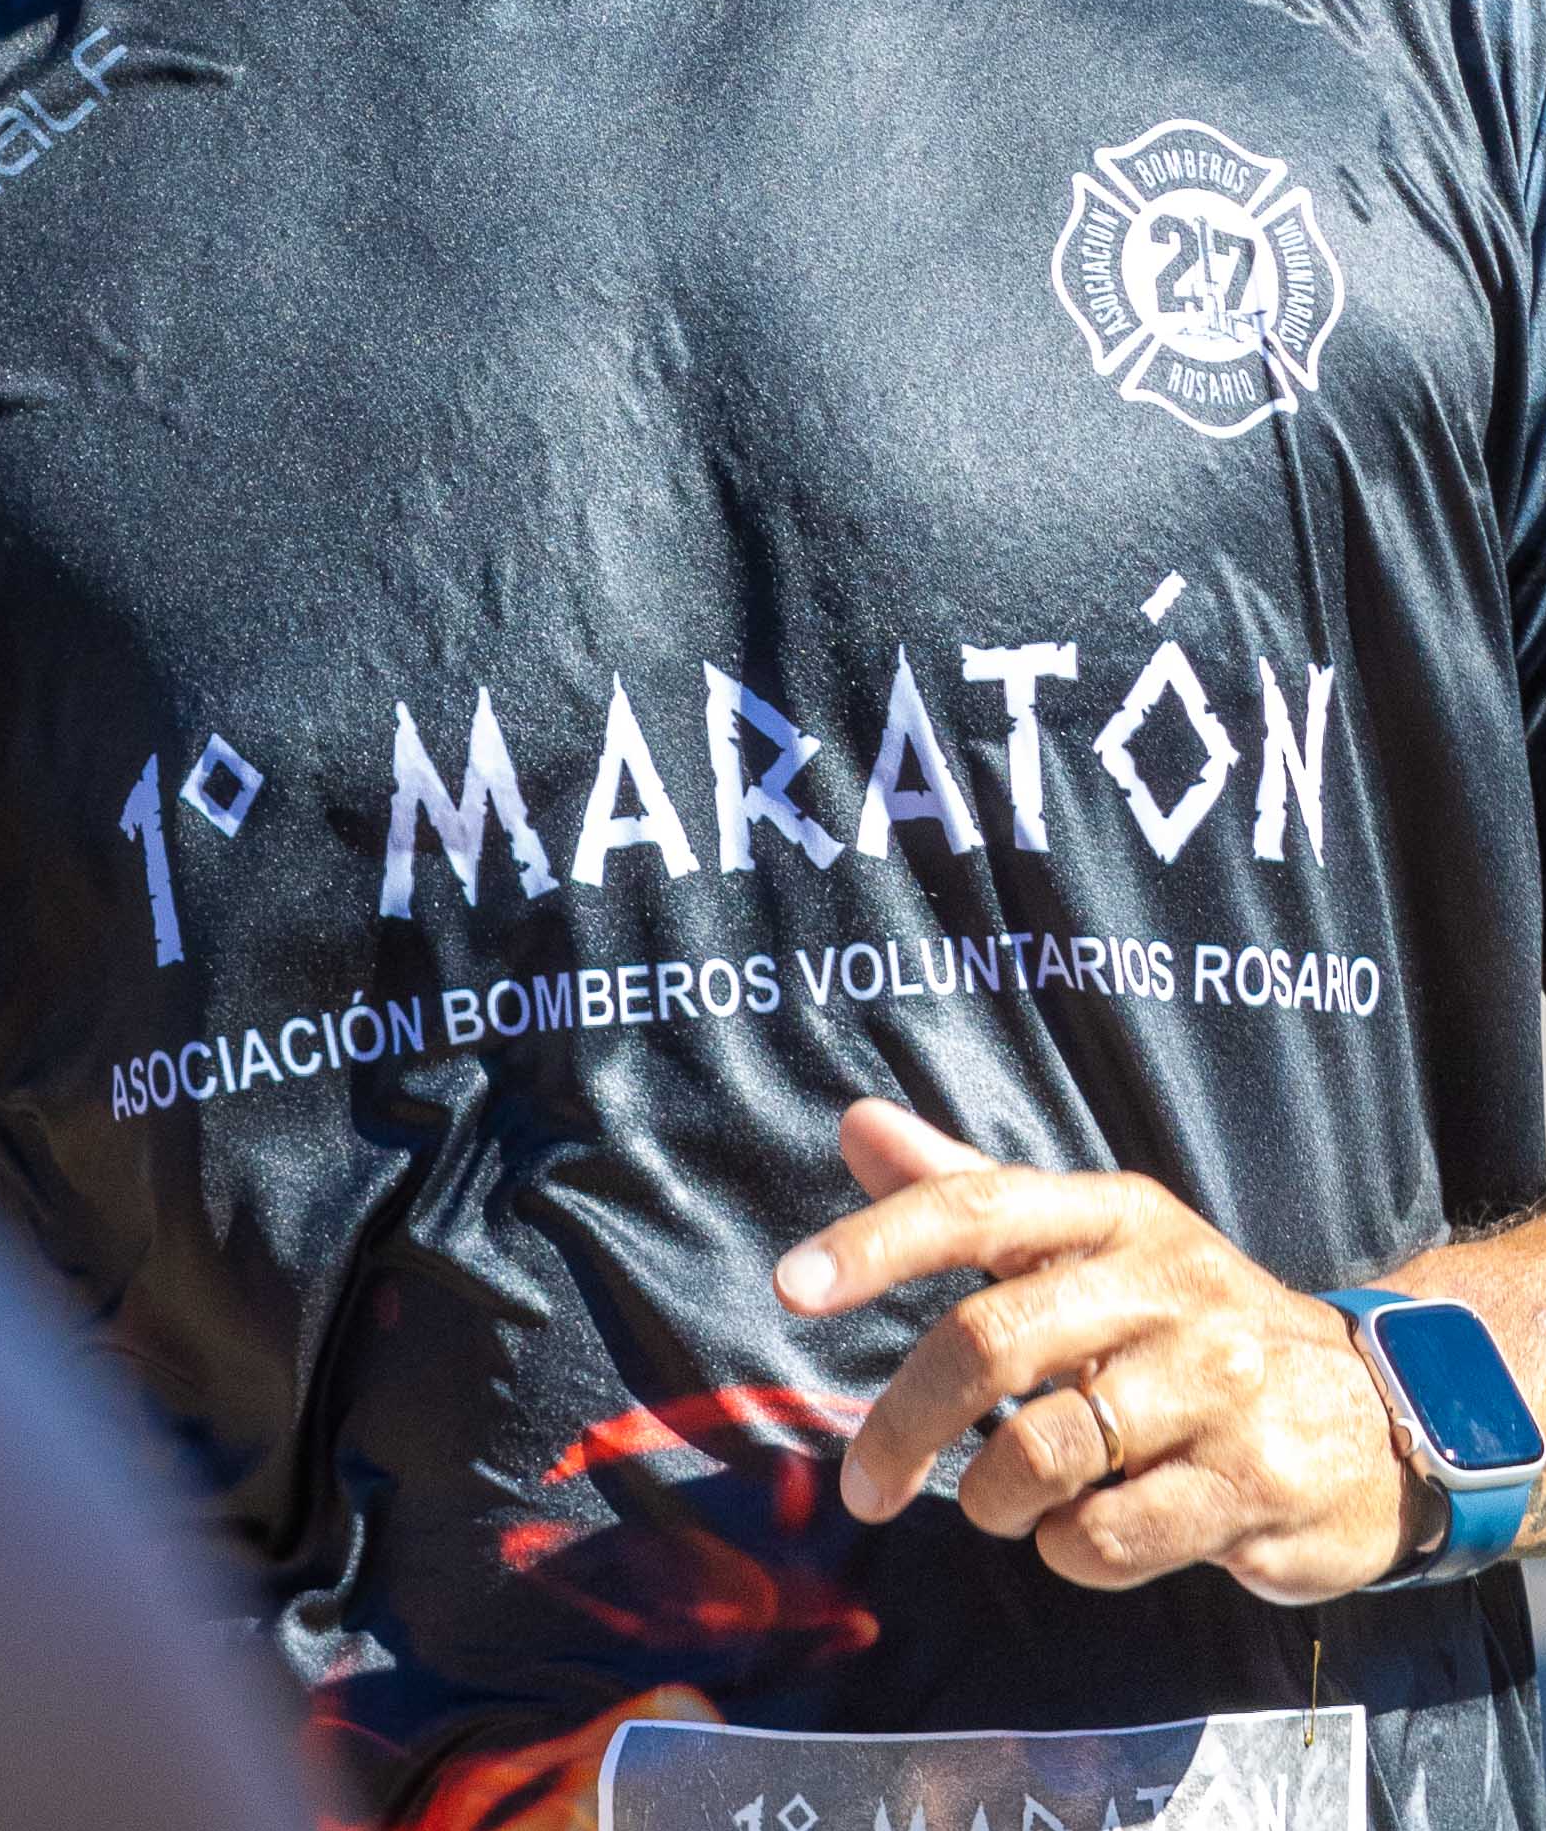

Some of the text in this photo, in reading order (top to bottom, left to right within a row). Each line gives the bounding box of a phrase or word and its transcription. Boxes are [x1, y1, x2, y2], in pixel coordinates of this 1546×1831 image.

[1135, 148, 1251, 194] BOMBEROS
[1150, 214, 1256, 314] 27
[1273, 218, 1315, 352] VOLUNTARIOS
[1167, 363, 1255, 405] ROSARIO
[379, 570, 1334, 920] MARATÓN
[111, 931, 1381, 1122] ASOCIACIÓN BOMBEROS VOLUNTARIOS ROSARIO
